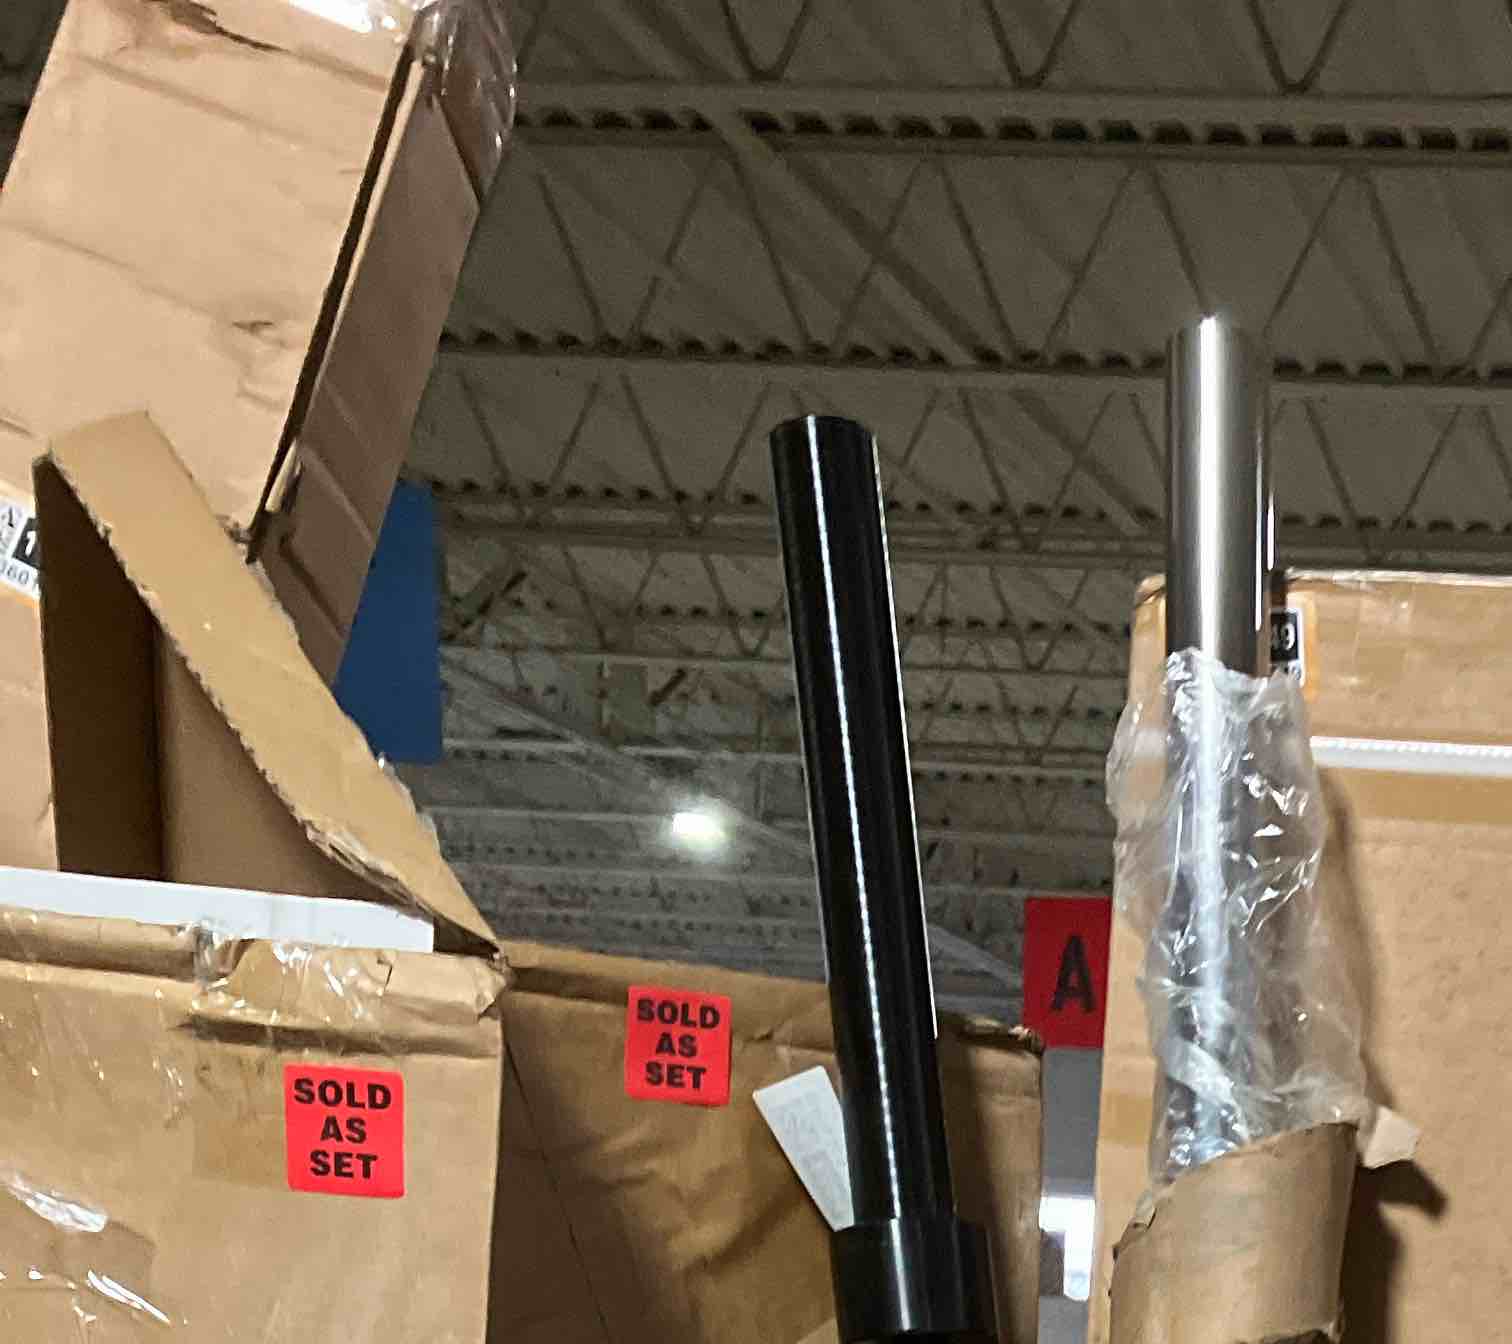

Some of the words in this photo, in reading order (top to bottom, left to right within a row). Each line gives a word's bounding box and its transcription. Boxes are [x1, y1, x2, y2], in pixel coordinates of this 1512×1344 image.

[1052, 934, 1096, 1012] A
[635, 997, 722, 1031] SOLD
[655, 1031, 698, 1058] AS
[645, 1061, 706, 1091] SET
[293, 1076, 393, 1111] SOLD
[320, 1114, 368, 1144] AS
[309, 1149, 379, 1181] SET
